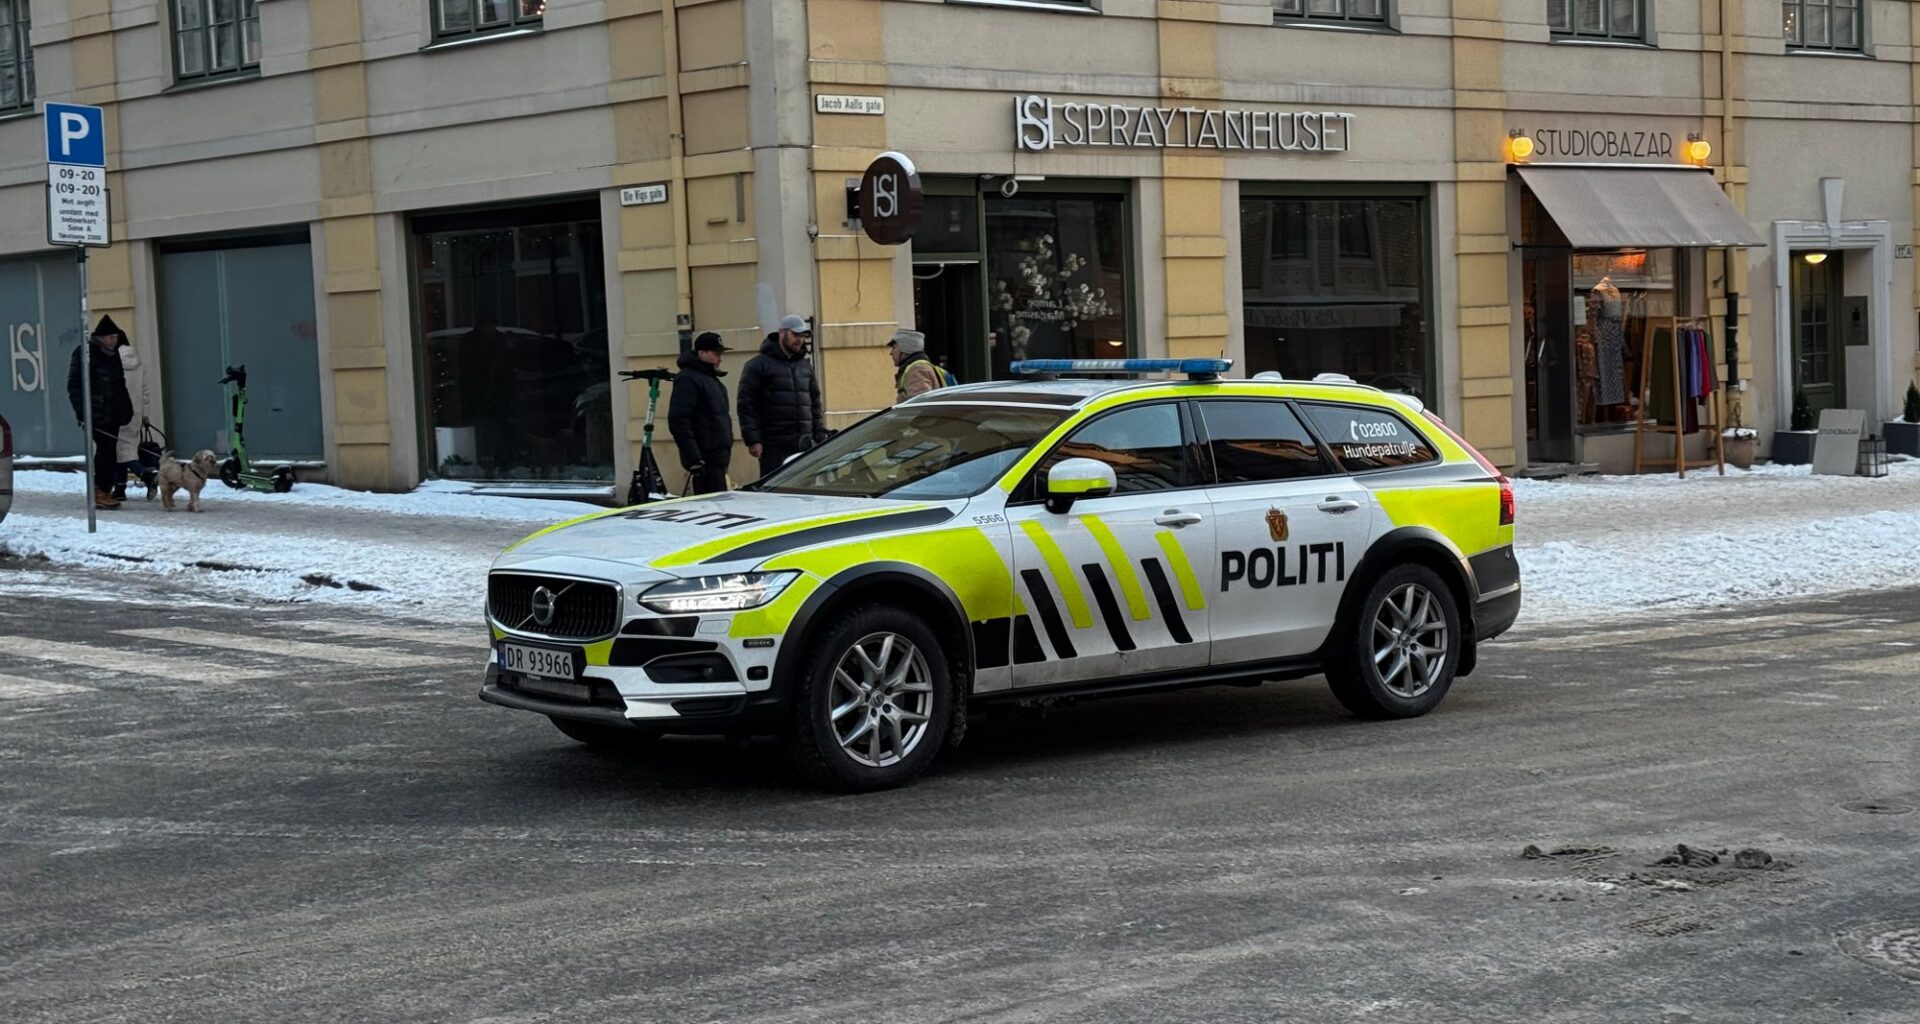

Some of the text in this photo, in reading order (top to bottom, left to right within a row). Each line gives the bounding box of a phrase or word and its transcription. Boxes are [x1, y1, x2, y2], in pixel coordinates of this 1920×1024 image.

[821, 97, 881, 113] Jacob Aalls gate
[60, 111, 90, 156] P
[1063, 102, 1355, 151] SPRAYTANHUSET
[1535, 128, 1672, 158] STUDIOBAZAR
[61, 198, 74, 206] Mot
[649, 187, 663, 202] gate
[67, 224, 84, 232] Sone
[1359, 421, 1398, 438] 02800
[1343, 440, 1417, 460] Hundepatrulje
[616, 509, 767, 530] POLITI
[972, 513, 1004, 525] 5566
[1220, 541, 1345, 592] POLITI
[507, 646, 571, 676] DR 93966
